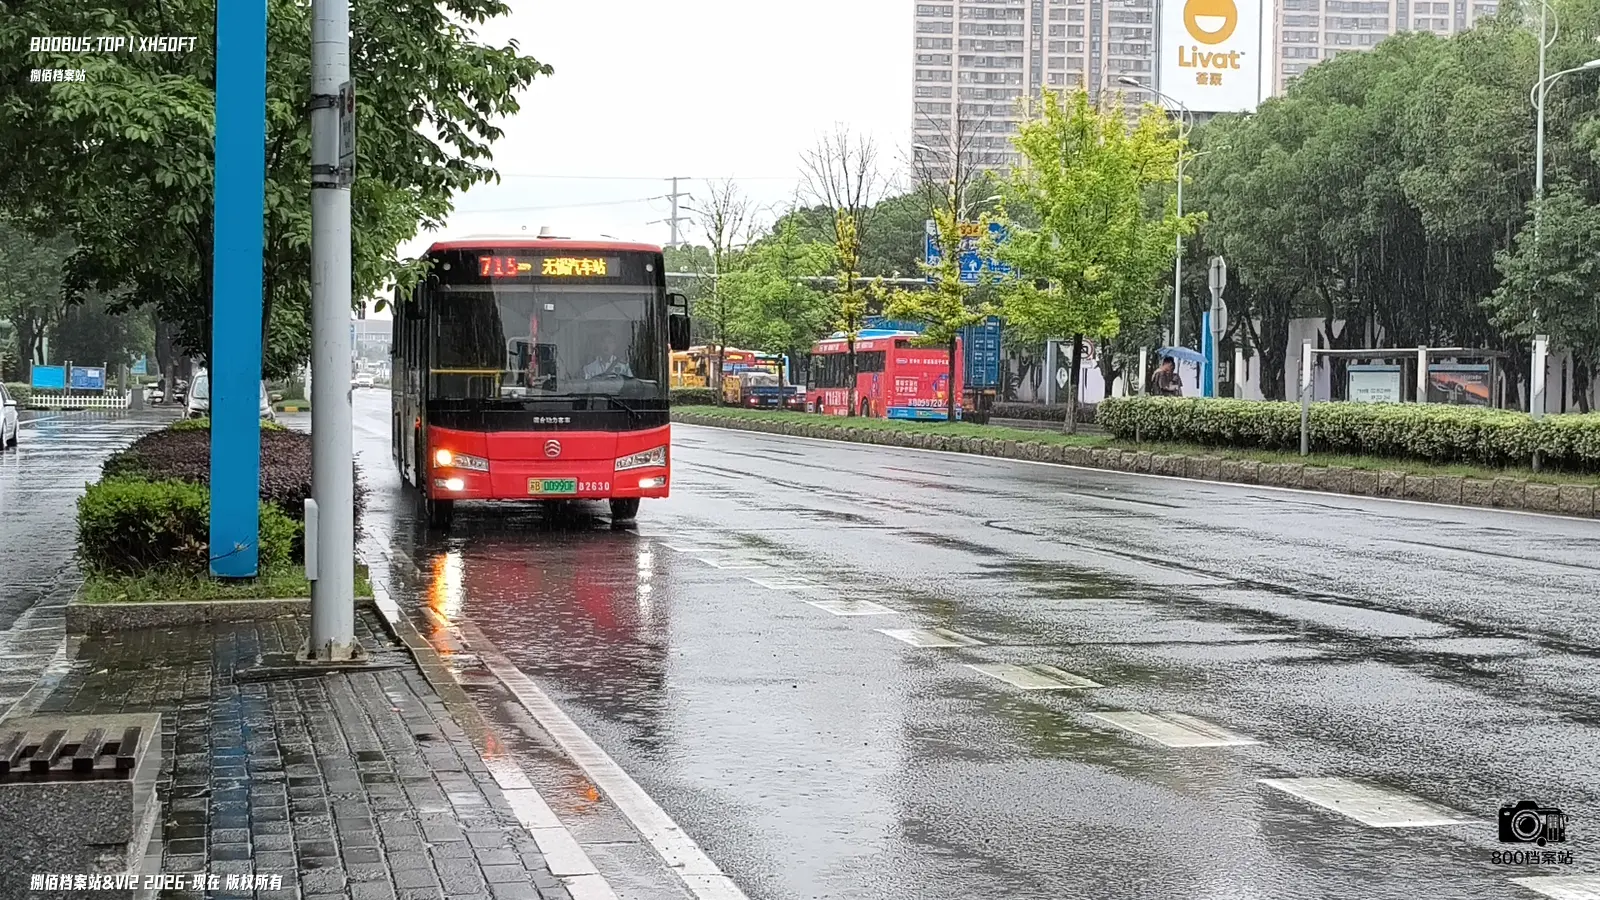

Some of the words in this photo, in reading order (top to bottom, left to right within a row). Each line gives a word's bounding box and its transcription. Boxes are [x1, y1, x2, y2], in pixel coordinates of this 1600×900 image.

[1178, 45, 1241, 69] Livat
[479, 257, 517, 276] 715
[541, 258, 607, 276] 无锡汽车站
[578, 481, 610, 491] B2630
